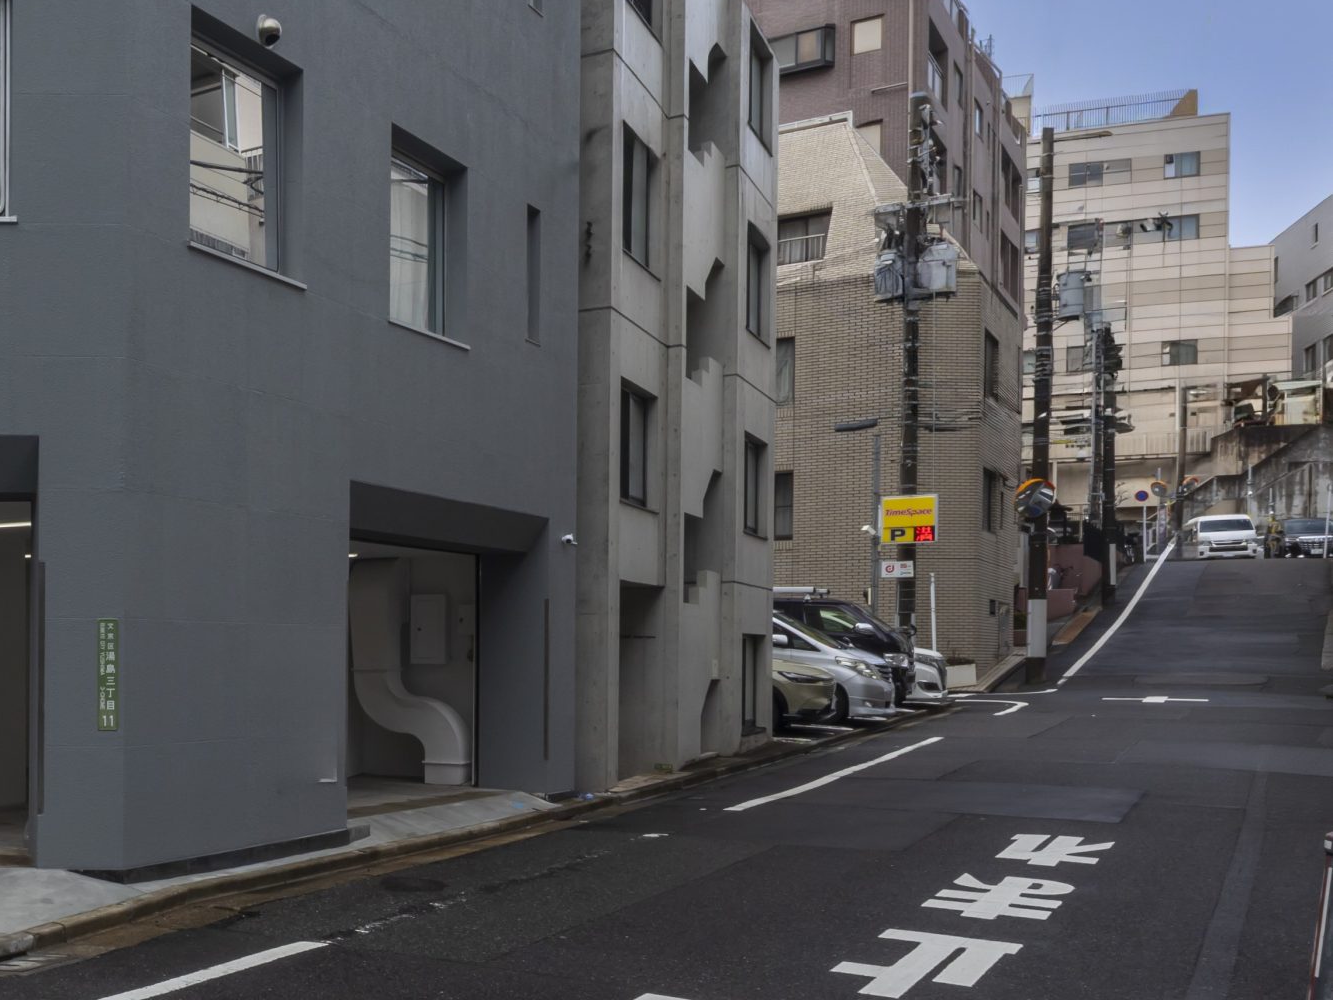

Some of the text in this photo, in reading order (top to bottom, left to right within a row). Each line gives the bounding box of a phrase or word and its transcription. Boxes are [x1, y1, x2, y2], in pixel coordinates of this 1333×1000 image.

[885, 508, 932, 517] TimeSpace
[890, 529, 906, 541] P
[916, 526, 933, 541] 満
[102, 715, 114, 727] 11
[829, 833, 1115, 999] 止まれ
